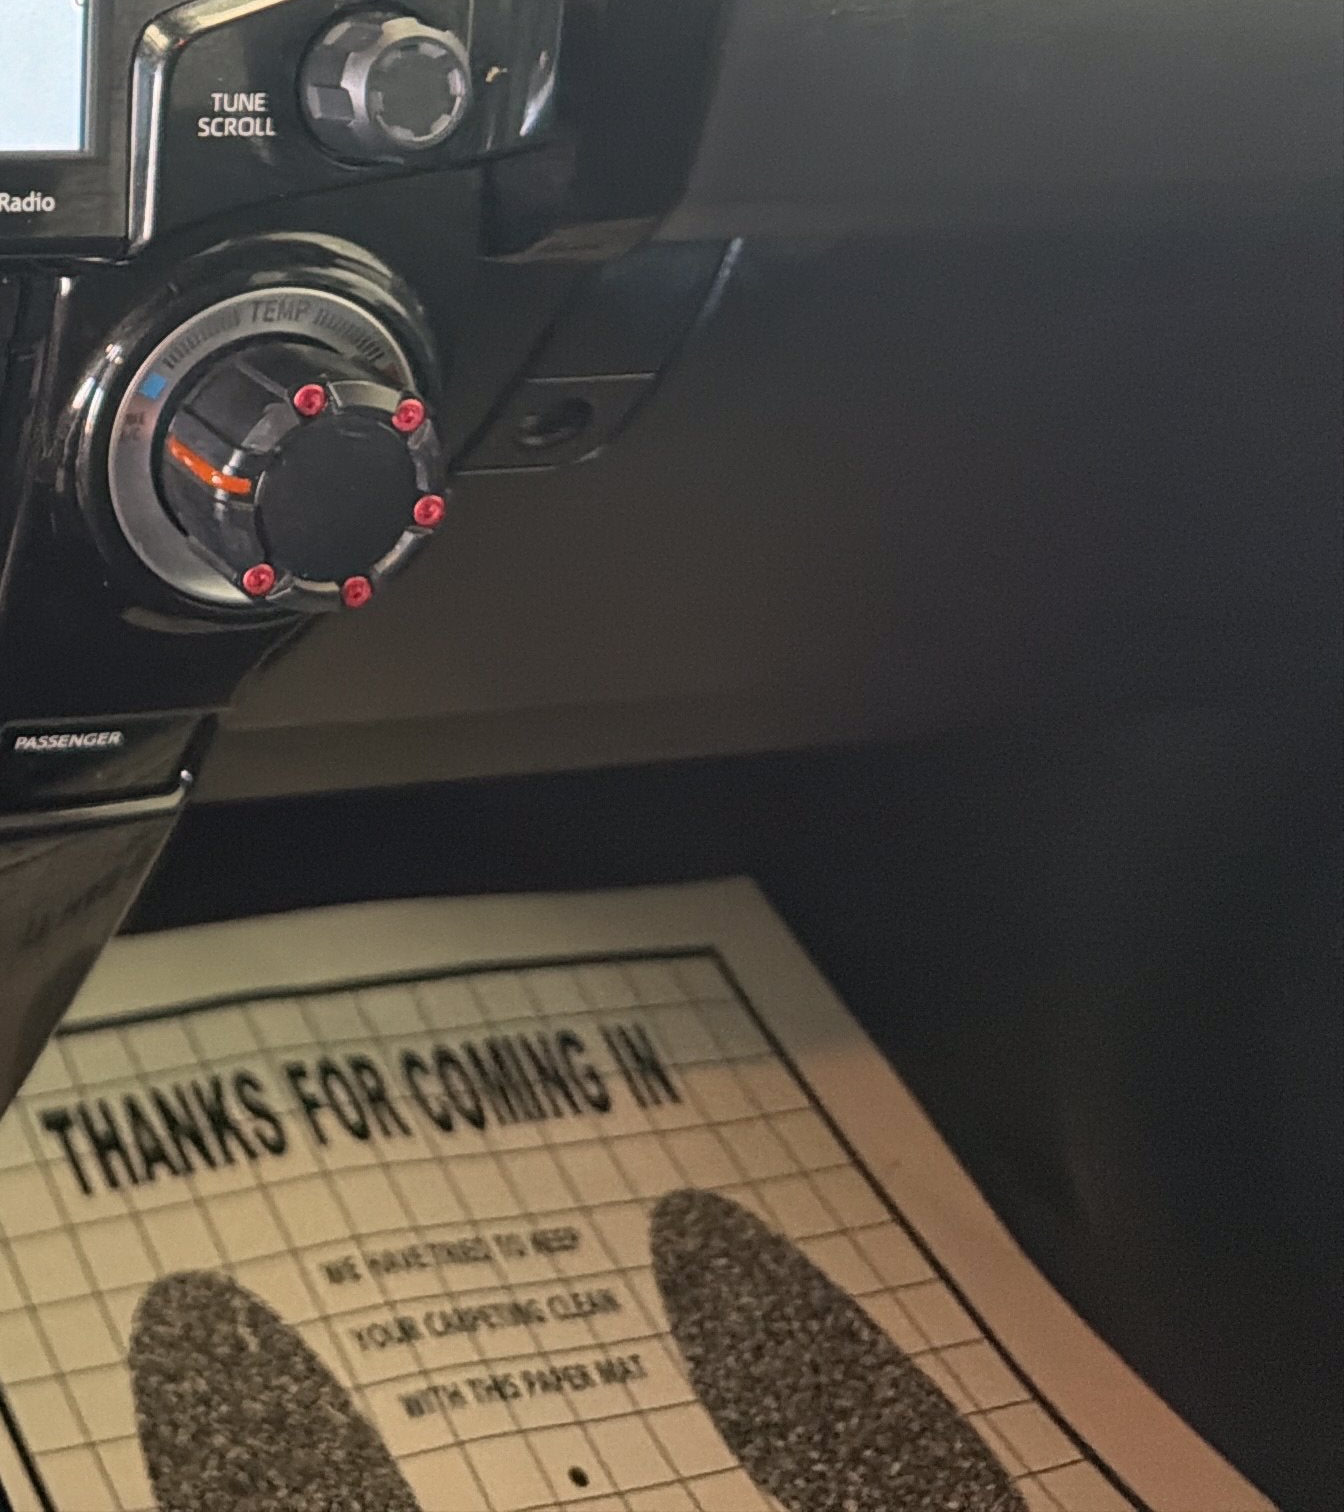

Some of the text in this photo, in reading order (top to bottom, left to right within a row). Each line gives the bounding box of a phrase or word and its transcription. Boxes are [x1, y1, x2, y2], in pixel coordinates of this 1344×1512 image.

[212, 93, 266, 113] TUNE
[197, 118, 276, 138] SCROLL
[251, 299, 309, 322] TEMP
[15, 731, 123, 750] PASSENGER
[41, 1023, 684, 1195] THANKS FOR COMING IN
